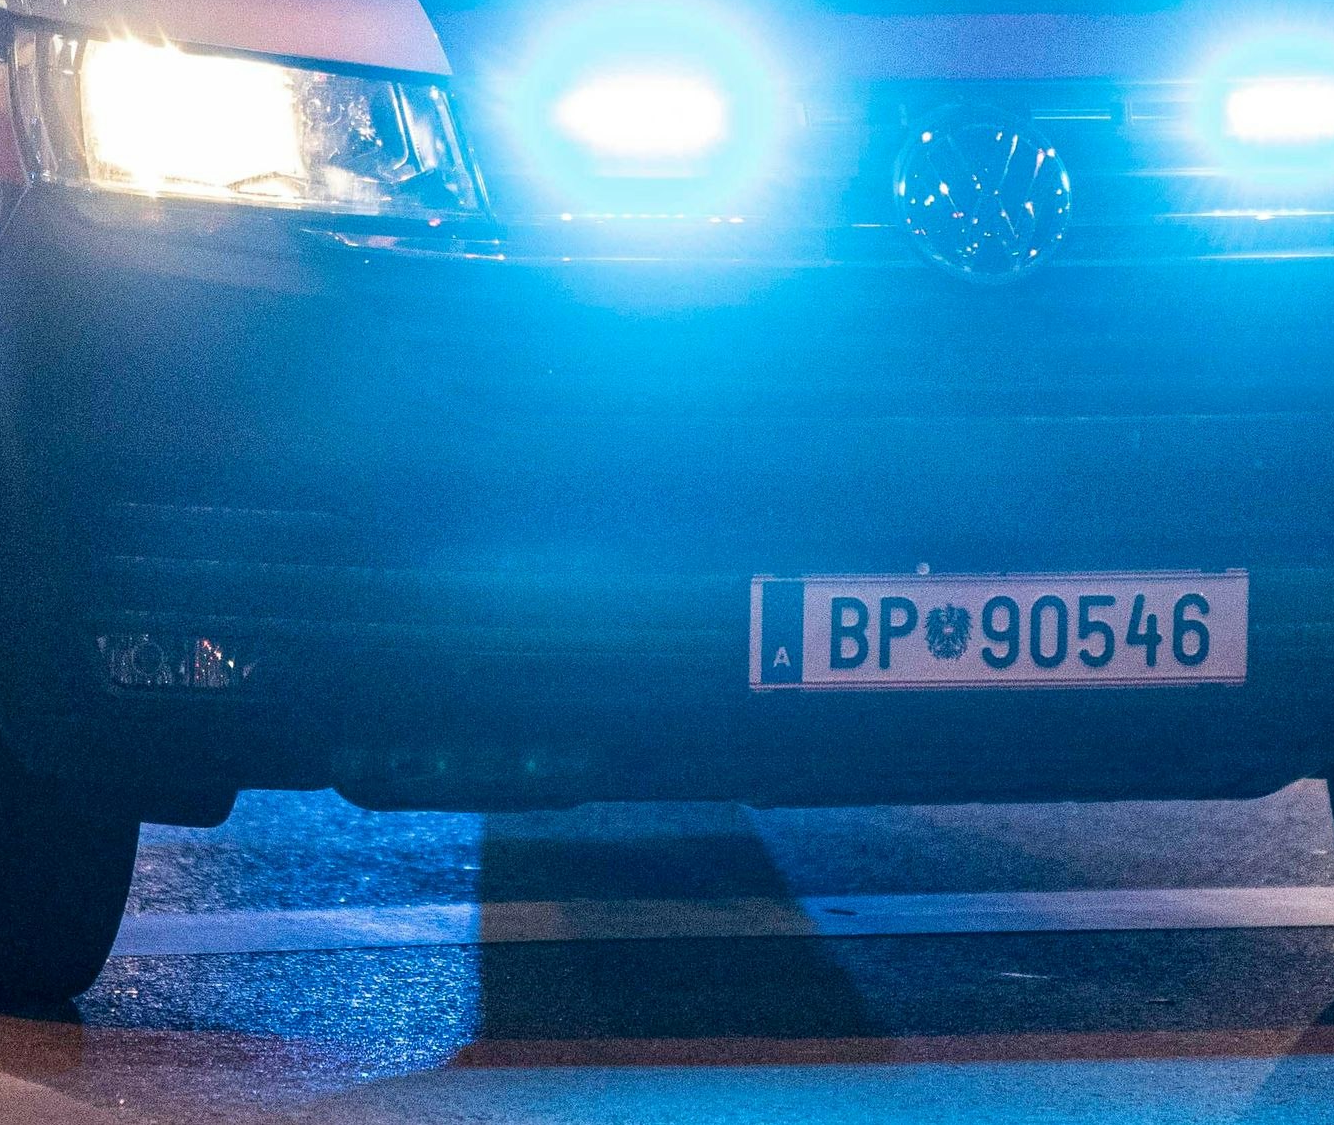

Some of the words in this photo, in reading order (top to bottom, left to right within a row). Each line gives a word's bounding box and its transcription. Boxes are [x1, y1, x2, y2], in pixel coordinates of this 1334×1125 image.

[772, 646, 792, 668] A
[829, 596, 918, 670] BP
[980, 593, 1211, 668] 90546
